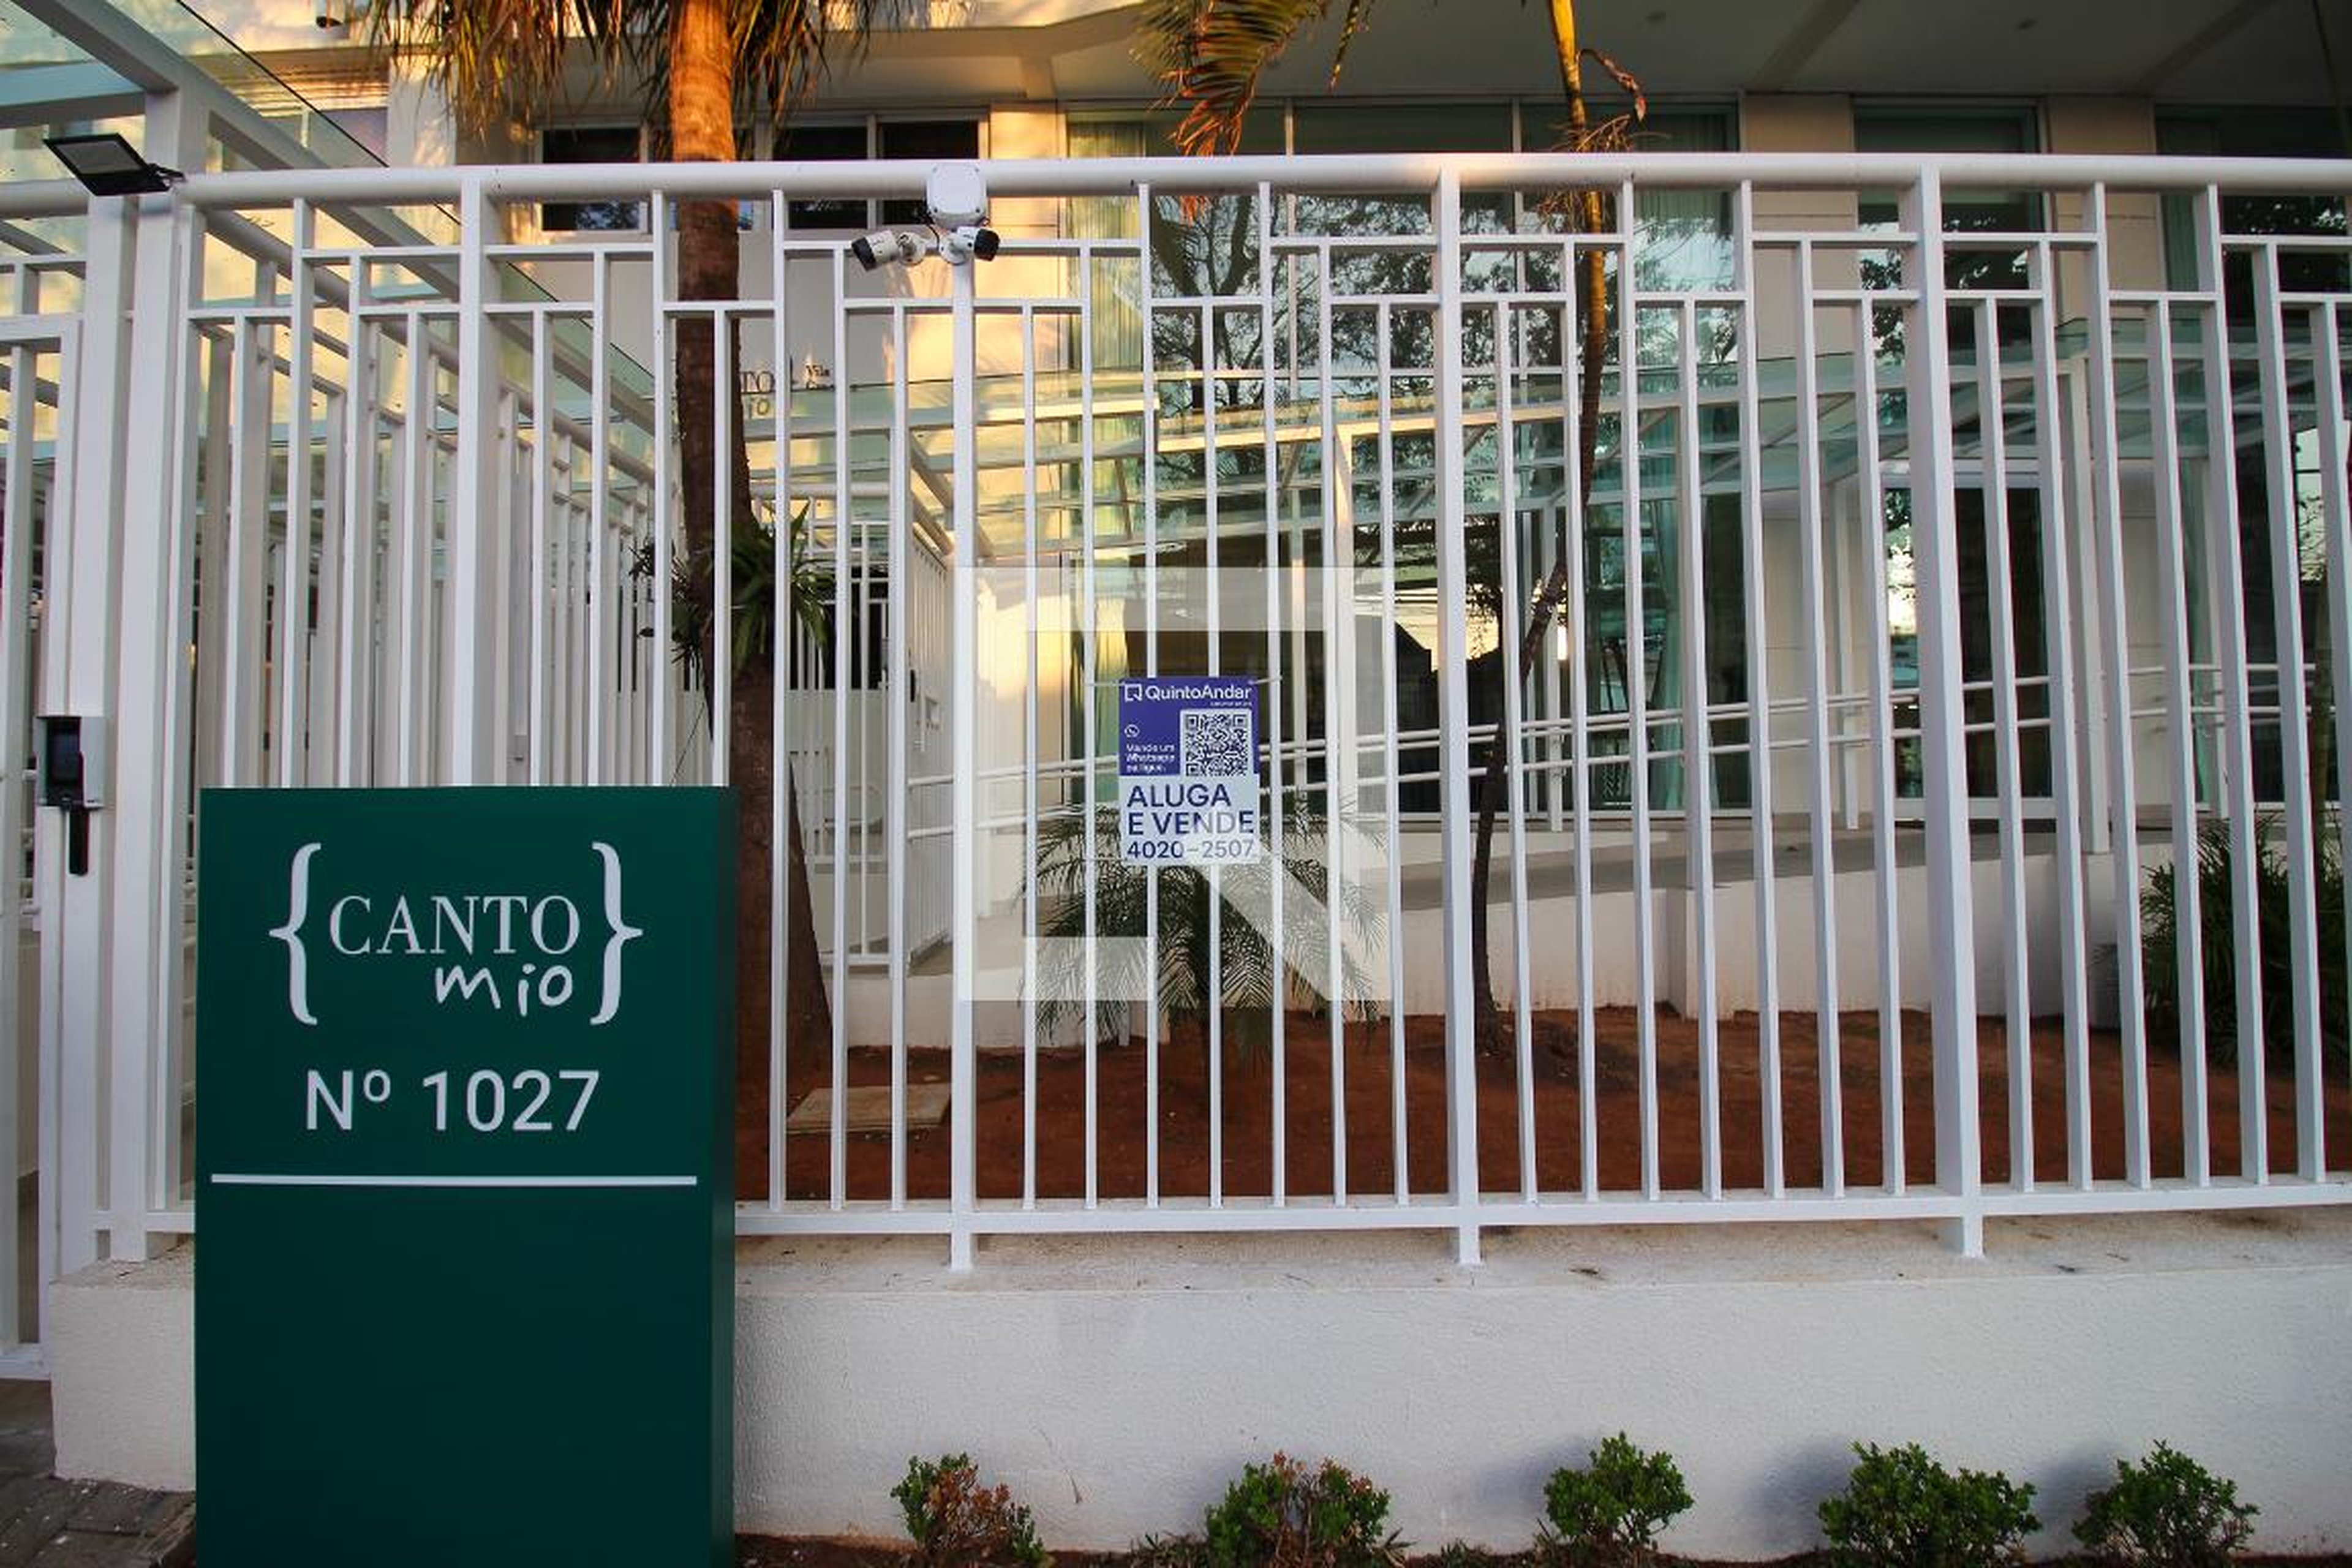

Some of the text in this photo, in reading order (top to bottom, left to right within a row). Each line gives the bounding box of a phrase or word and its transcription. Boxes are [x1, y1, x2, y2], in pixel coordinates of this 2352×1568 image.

[1145, 685, 1253, 701] QuintoAndar
[1127, 783, 1231, 808] ALUGA
[1128, 810, 1254, 835] E VENDE
[1127, 839, 1254, 859] 4020-2507
[329, 895, 581, 955] CANTO
[434, 963, 573, 1017] mio
[423, 1069, 600, 1132] 1027
